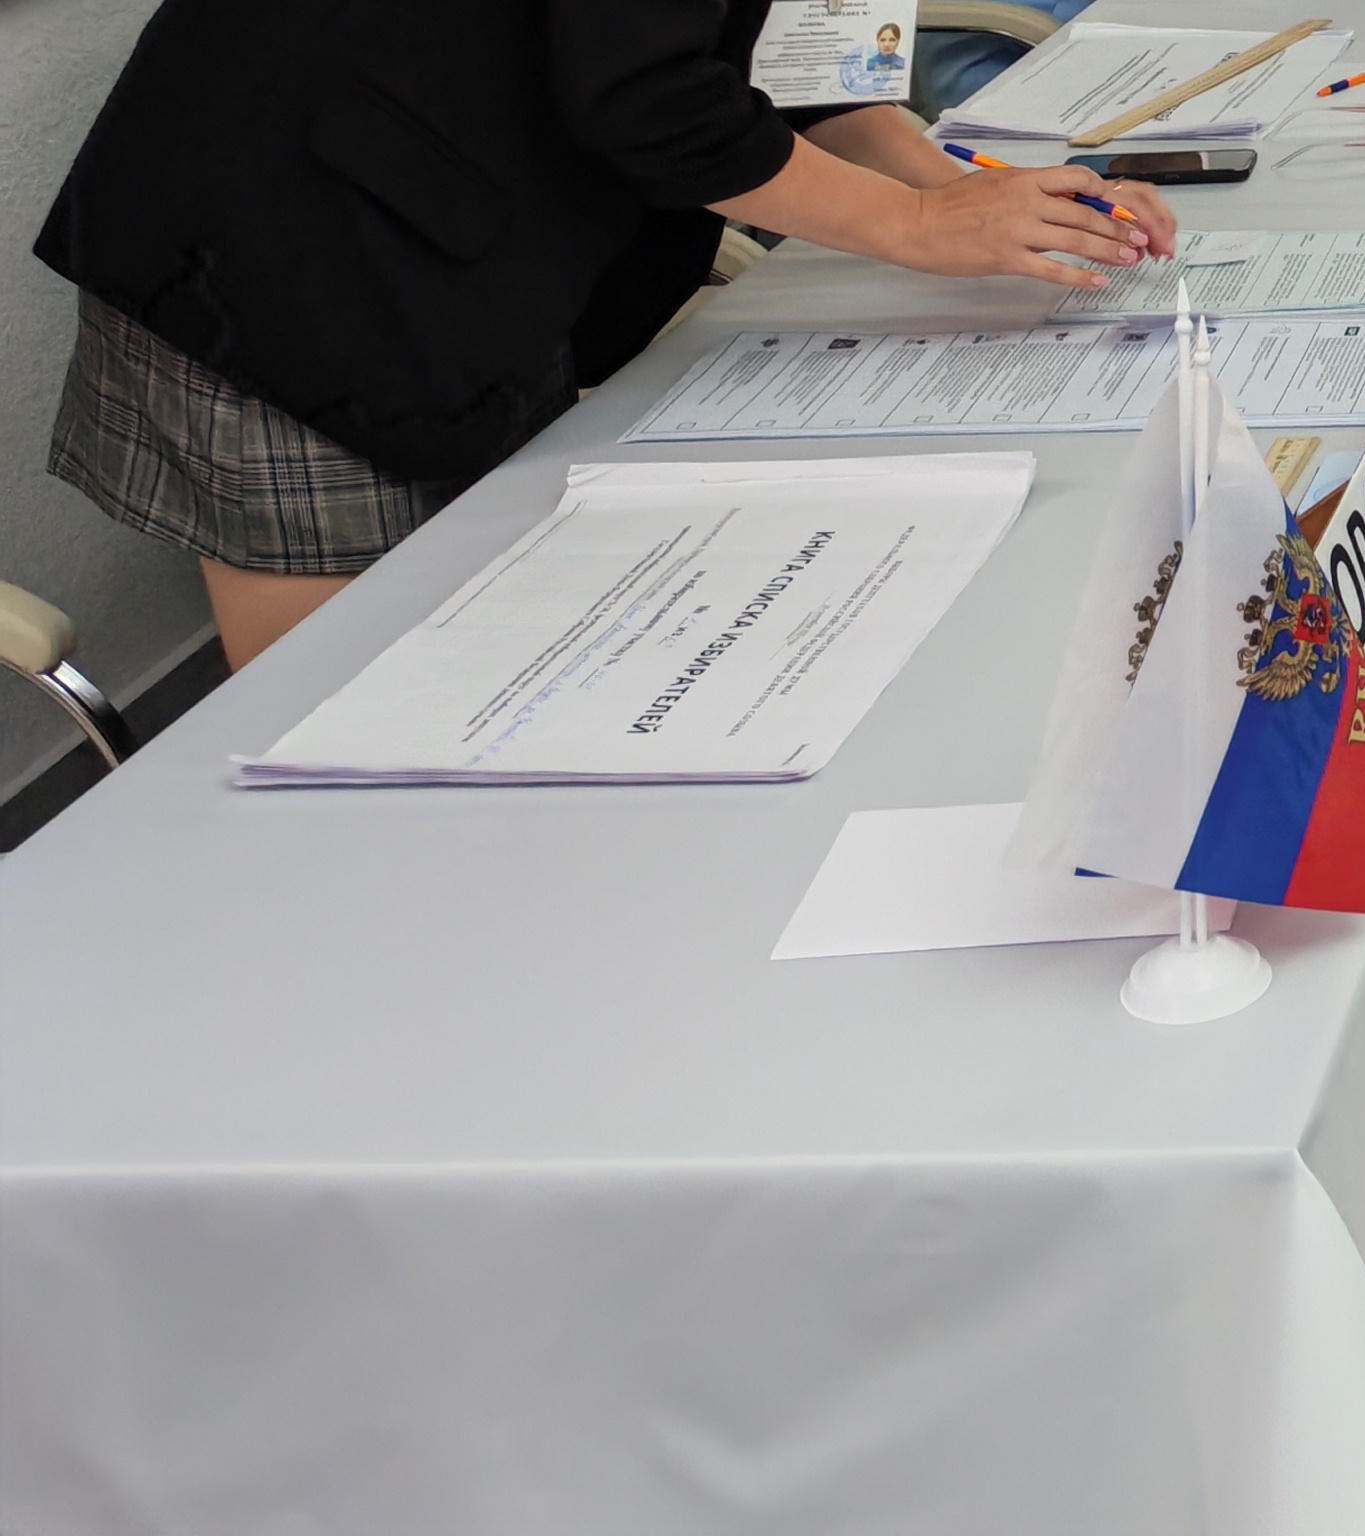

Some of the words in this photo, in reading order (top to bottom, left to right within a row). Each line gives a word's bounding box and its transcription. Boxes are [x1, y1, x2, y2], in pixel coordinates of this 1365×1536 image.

[779, 531, 838, 572] КНИГА
[725, 576, 796, 628] СПИСКА
[623, 632, 743, 734] ИЗБИРАТЕЛЕЙ
